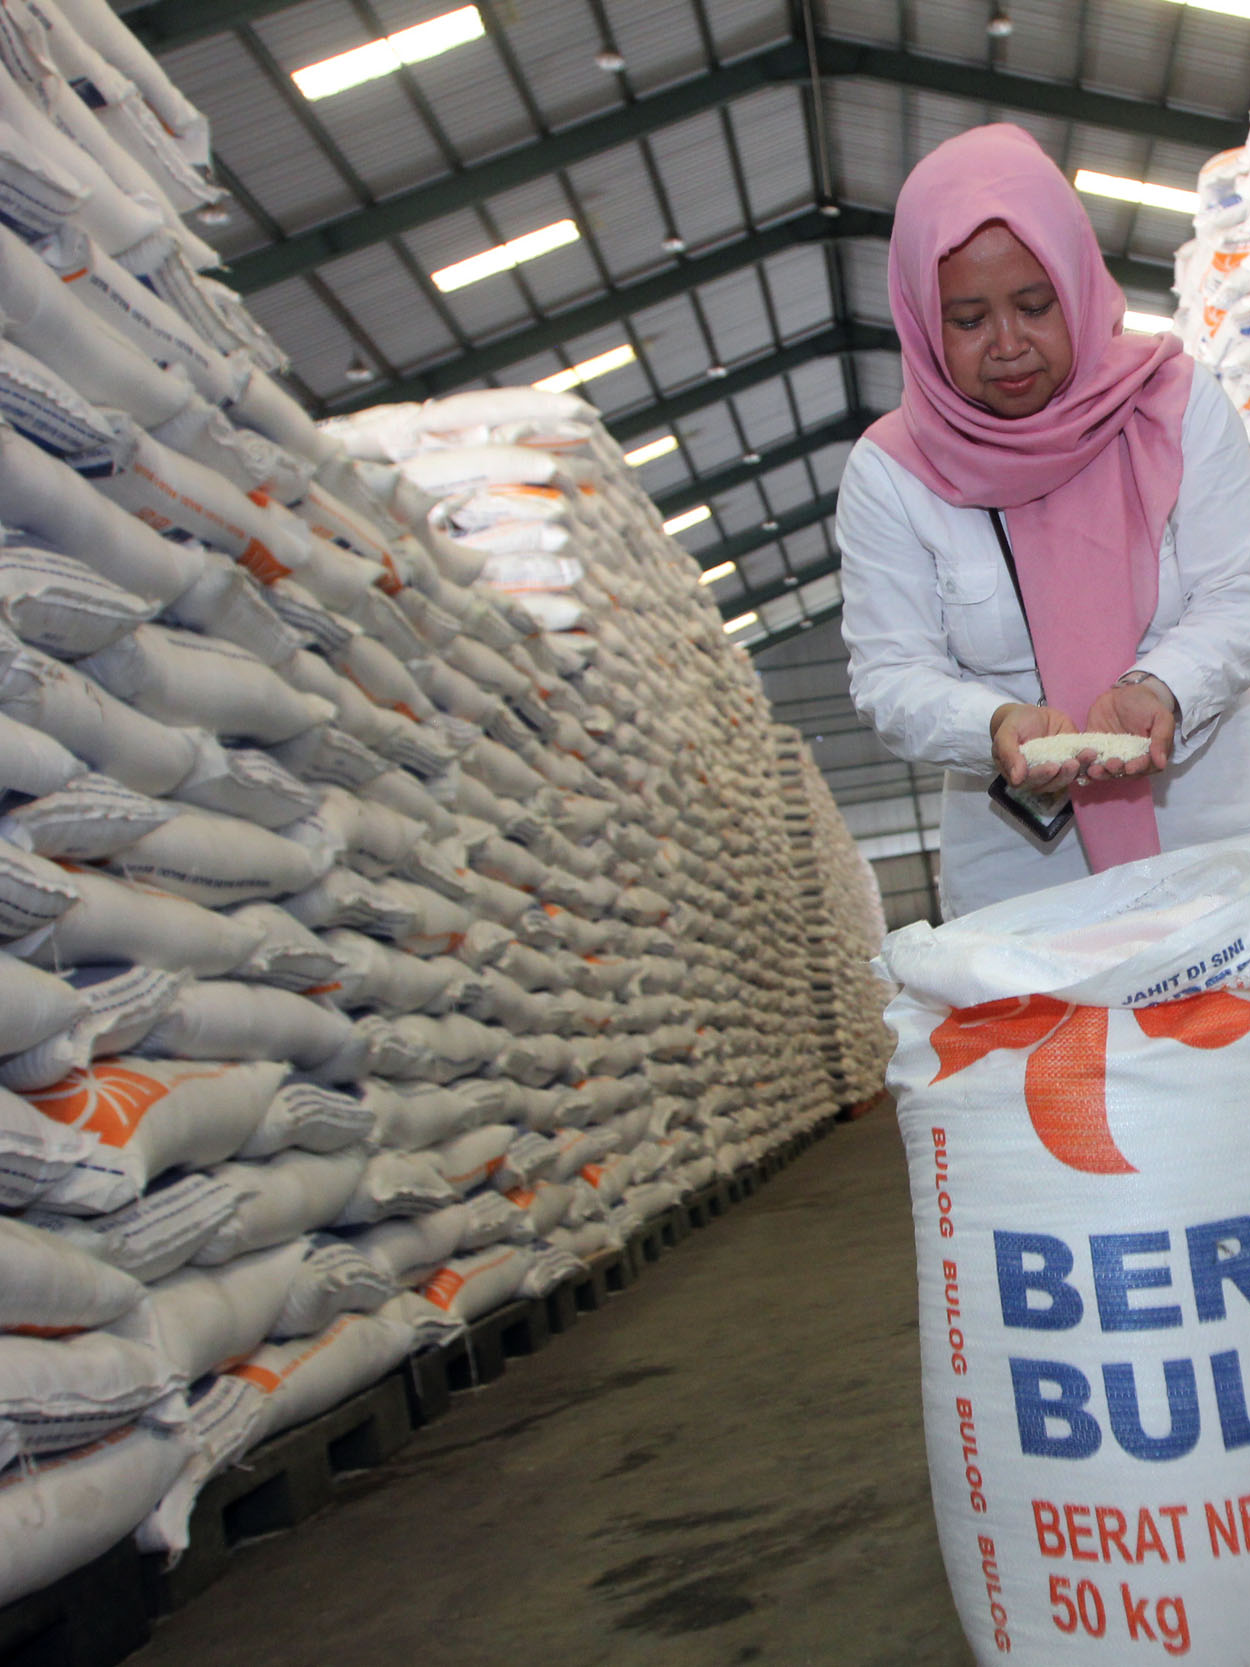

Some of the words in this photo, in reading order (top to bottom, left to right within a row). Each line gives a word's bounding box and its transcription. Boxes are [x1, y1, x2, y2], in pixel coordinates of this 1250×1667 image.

[1121, 973, 1181, 1006] JAHIT
[1187, 961, 1207, 981] DI
[1211, 938, 1246, 968] SINI
[931, 1127, 953, 1239] BULOG
[943, 1260, 967, 1376] BULOG
[956, 1397, 987, 1514] BULOG
[977, 1535, 1011, 1654] BULOG
[1031, 1499, 1188, 1564] BERAT
[1048, 1576, 1106, 1638] 50
[1120, 1584, 1191, 1657] kg
